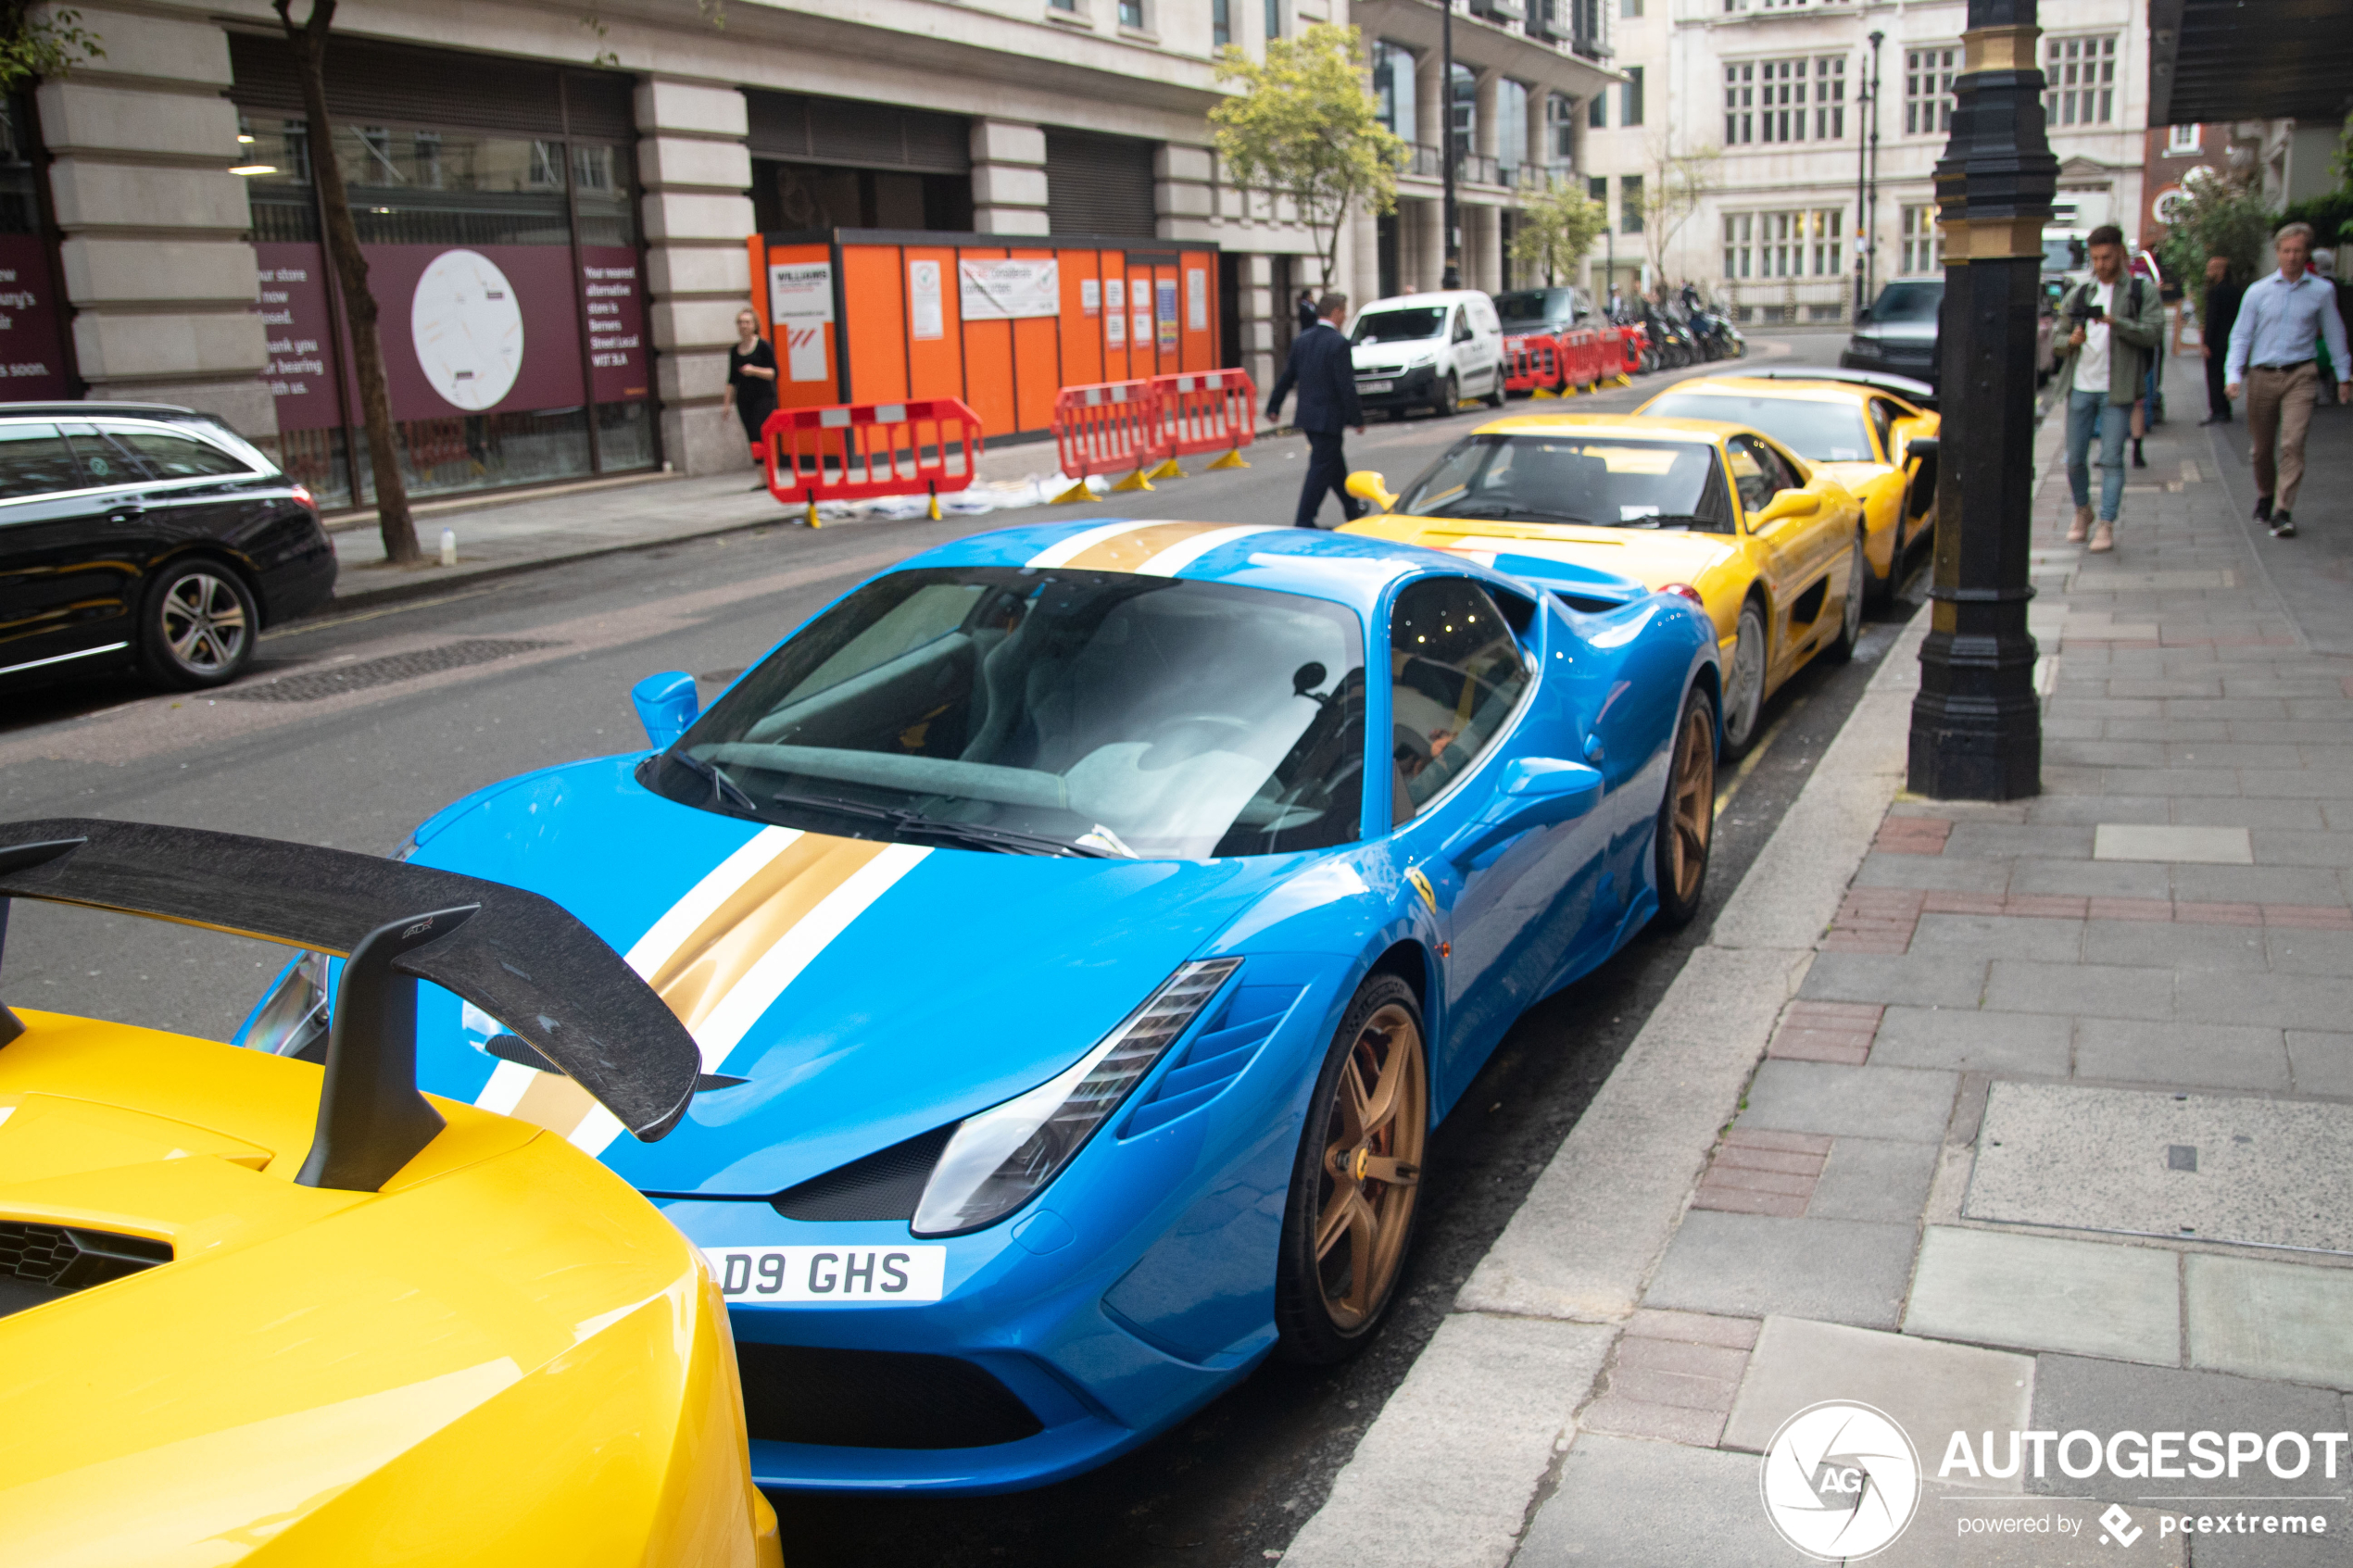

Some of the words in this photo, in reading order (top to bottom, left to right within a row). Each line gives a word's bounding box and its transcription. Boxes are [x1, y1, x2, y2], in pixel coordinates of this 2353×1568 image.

[0, 269, 17, 282] ew
[257, 269, 273, 282] our
[276, 267, 308, 282] store
[777, 270, 828, 282] WILLIAMS
[585, 282, 632, 297] alternative
[258, 308, 295, 324] osed.
[294, 339, 320, 356] you
[271, 380, 290, 395] ith
[723, 1253, 786, 1295] D9
[808, 1252, 911, 1294] GHS
